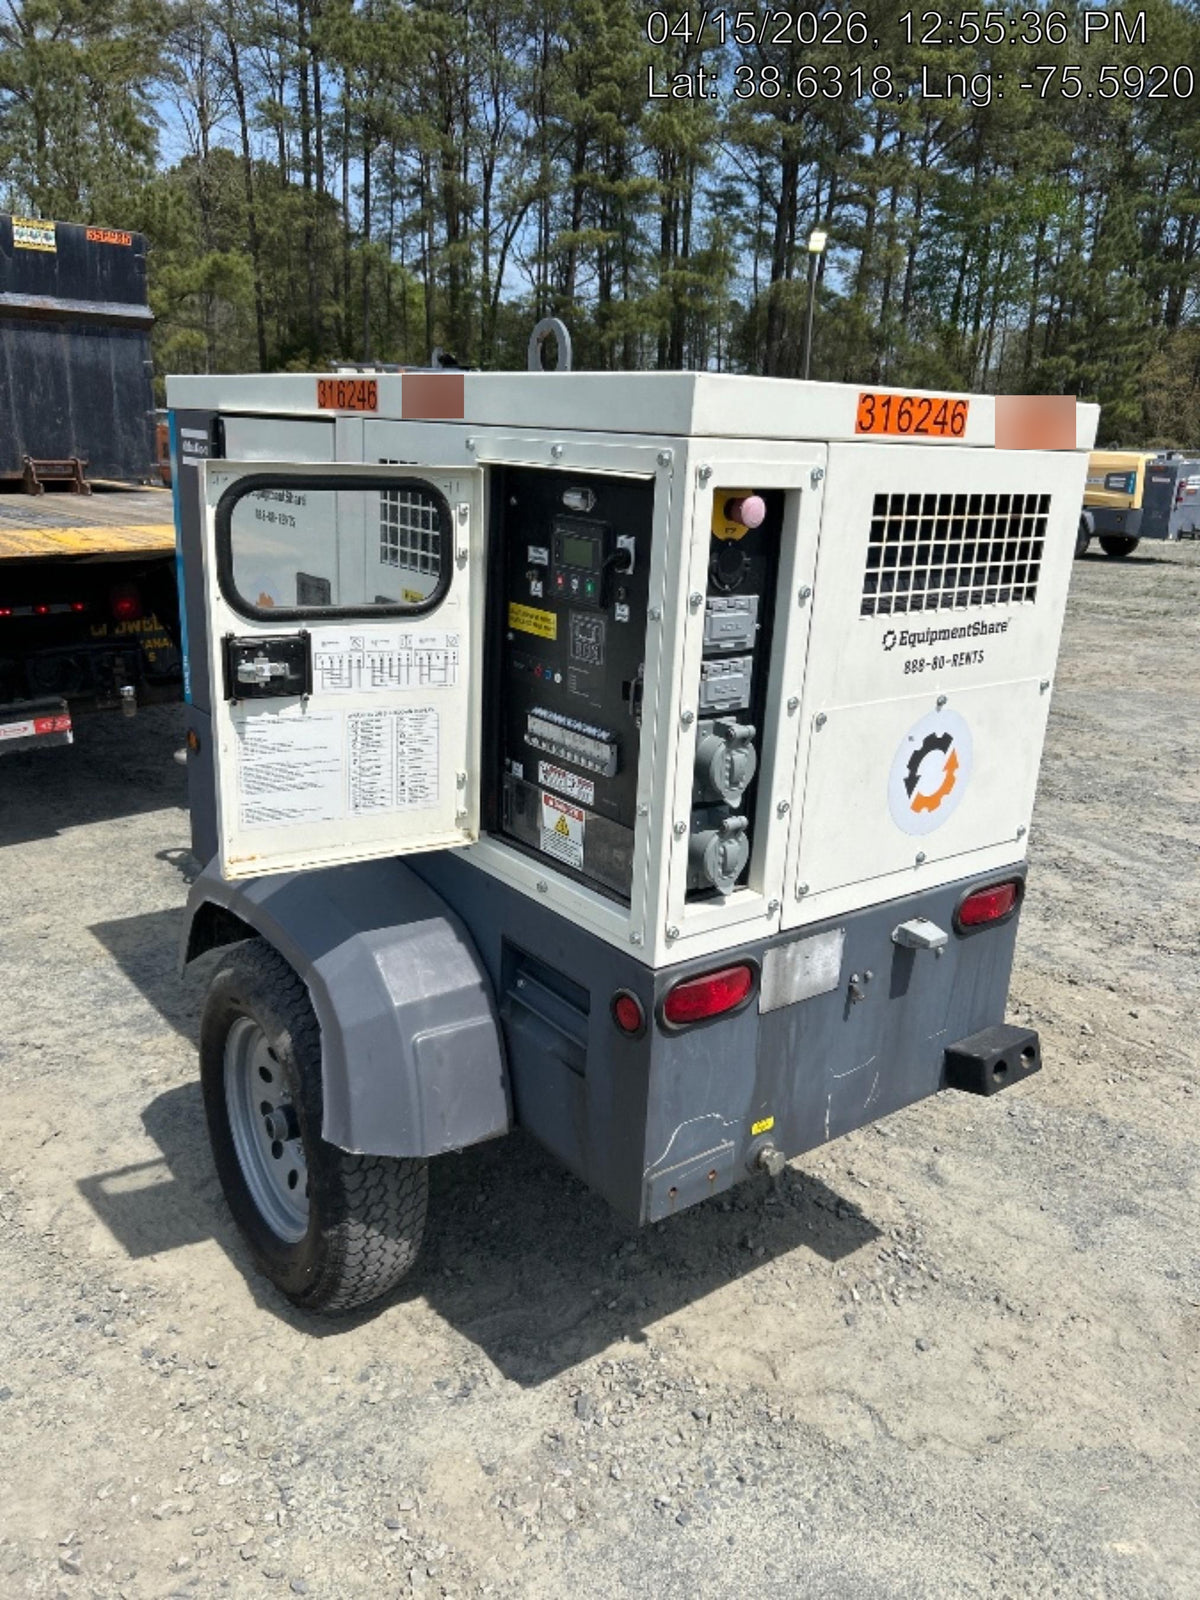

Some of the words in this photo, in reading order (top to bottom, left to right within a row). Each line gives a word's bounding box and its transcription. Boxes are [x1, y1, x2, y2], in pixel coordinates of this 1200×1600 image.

[318, 379, 377, 410] 316246
[858, 394, 967, 435] 316246
[899, 620, 1009, 648] EquipmentShare
[903, 649, 985, 675] 888-80-RENTS
